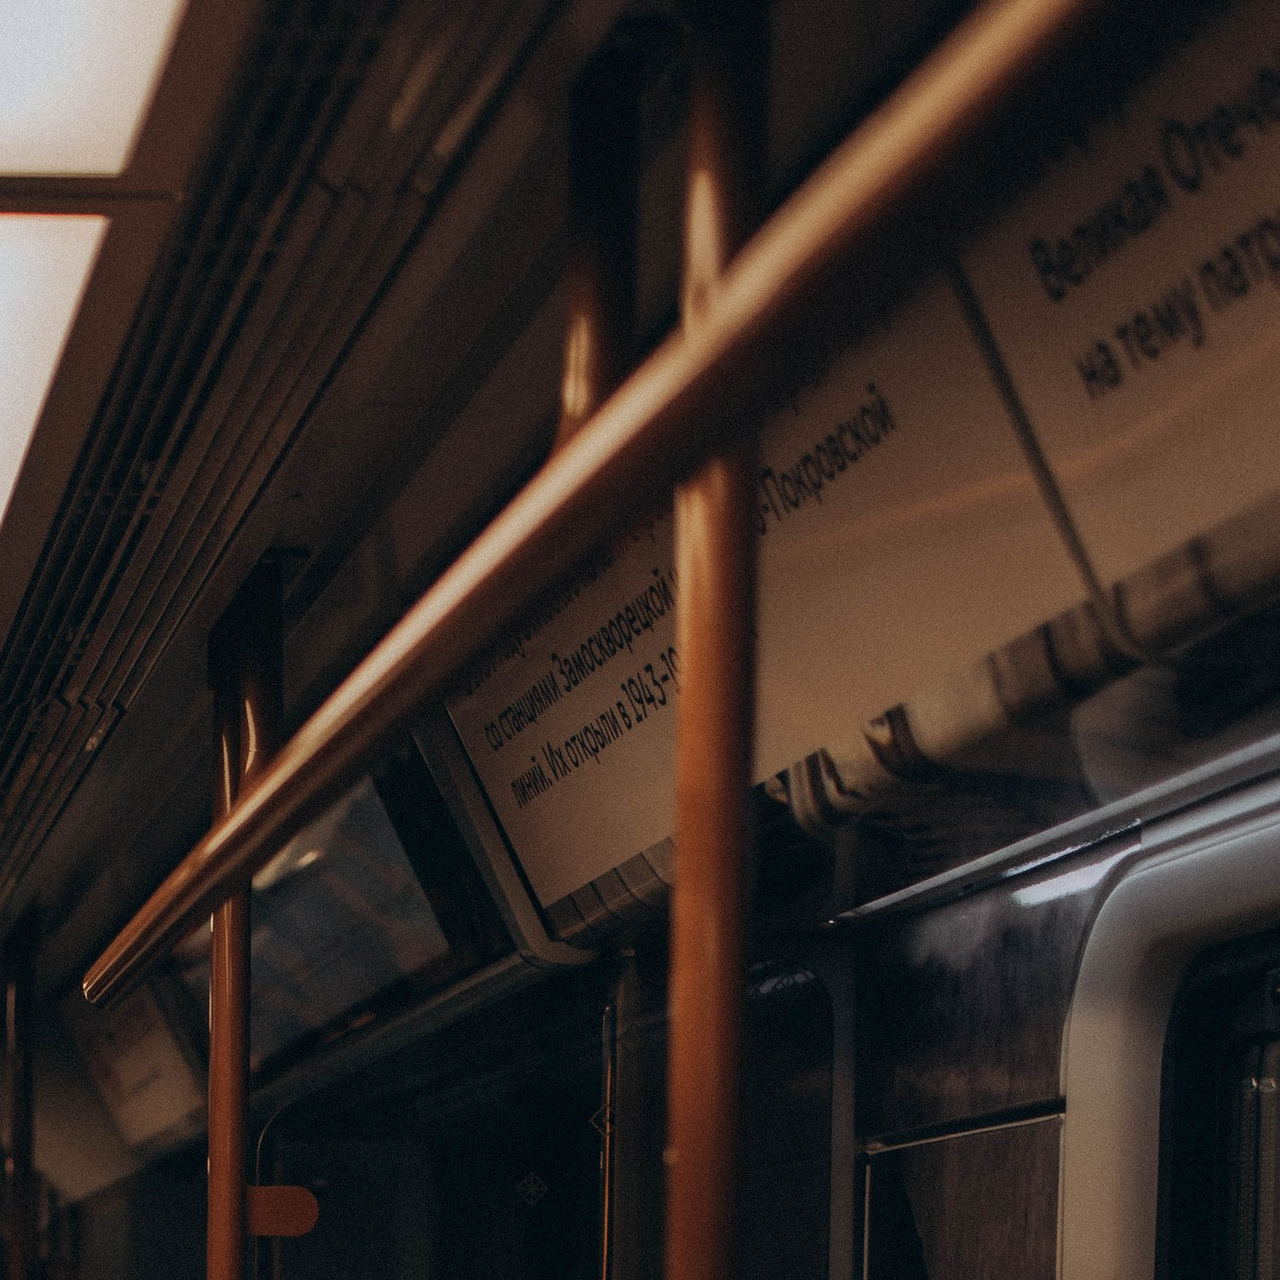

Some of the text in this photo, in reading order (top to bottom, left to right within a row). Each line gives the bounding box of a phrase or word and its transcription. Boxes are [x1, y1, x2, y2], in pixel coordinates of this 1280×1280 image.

[1030, 164, 1168, 300] Великая
[1077, 341, 1121, 398] на
[1116, 277, 1205, 369] тему
[484, 721, 504, 751] со
[498, 672, 563, 742] станциями
[551, 568, 674, 692] Замоскворецкой
[510, 755, 553, 809] линий.
[541, 741, 572, 781] Их
[567, 712, 624, 764] открыли
[616, 701, 632, 731] в
